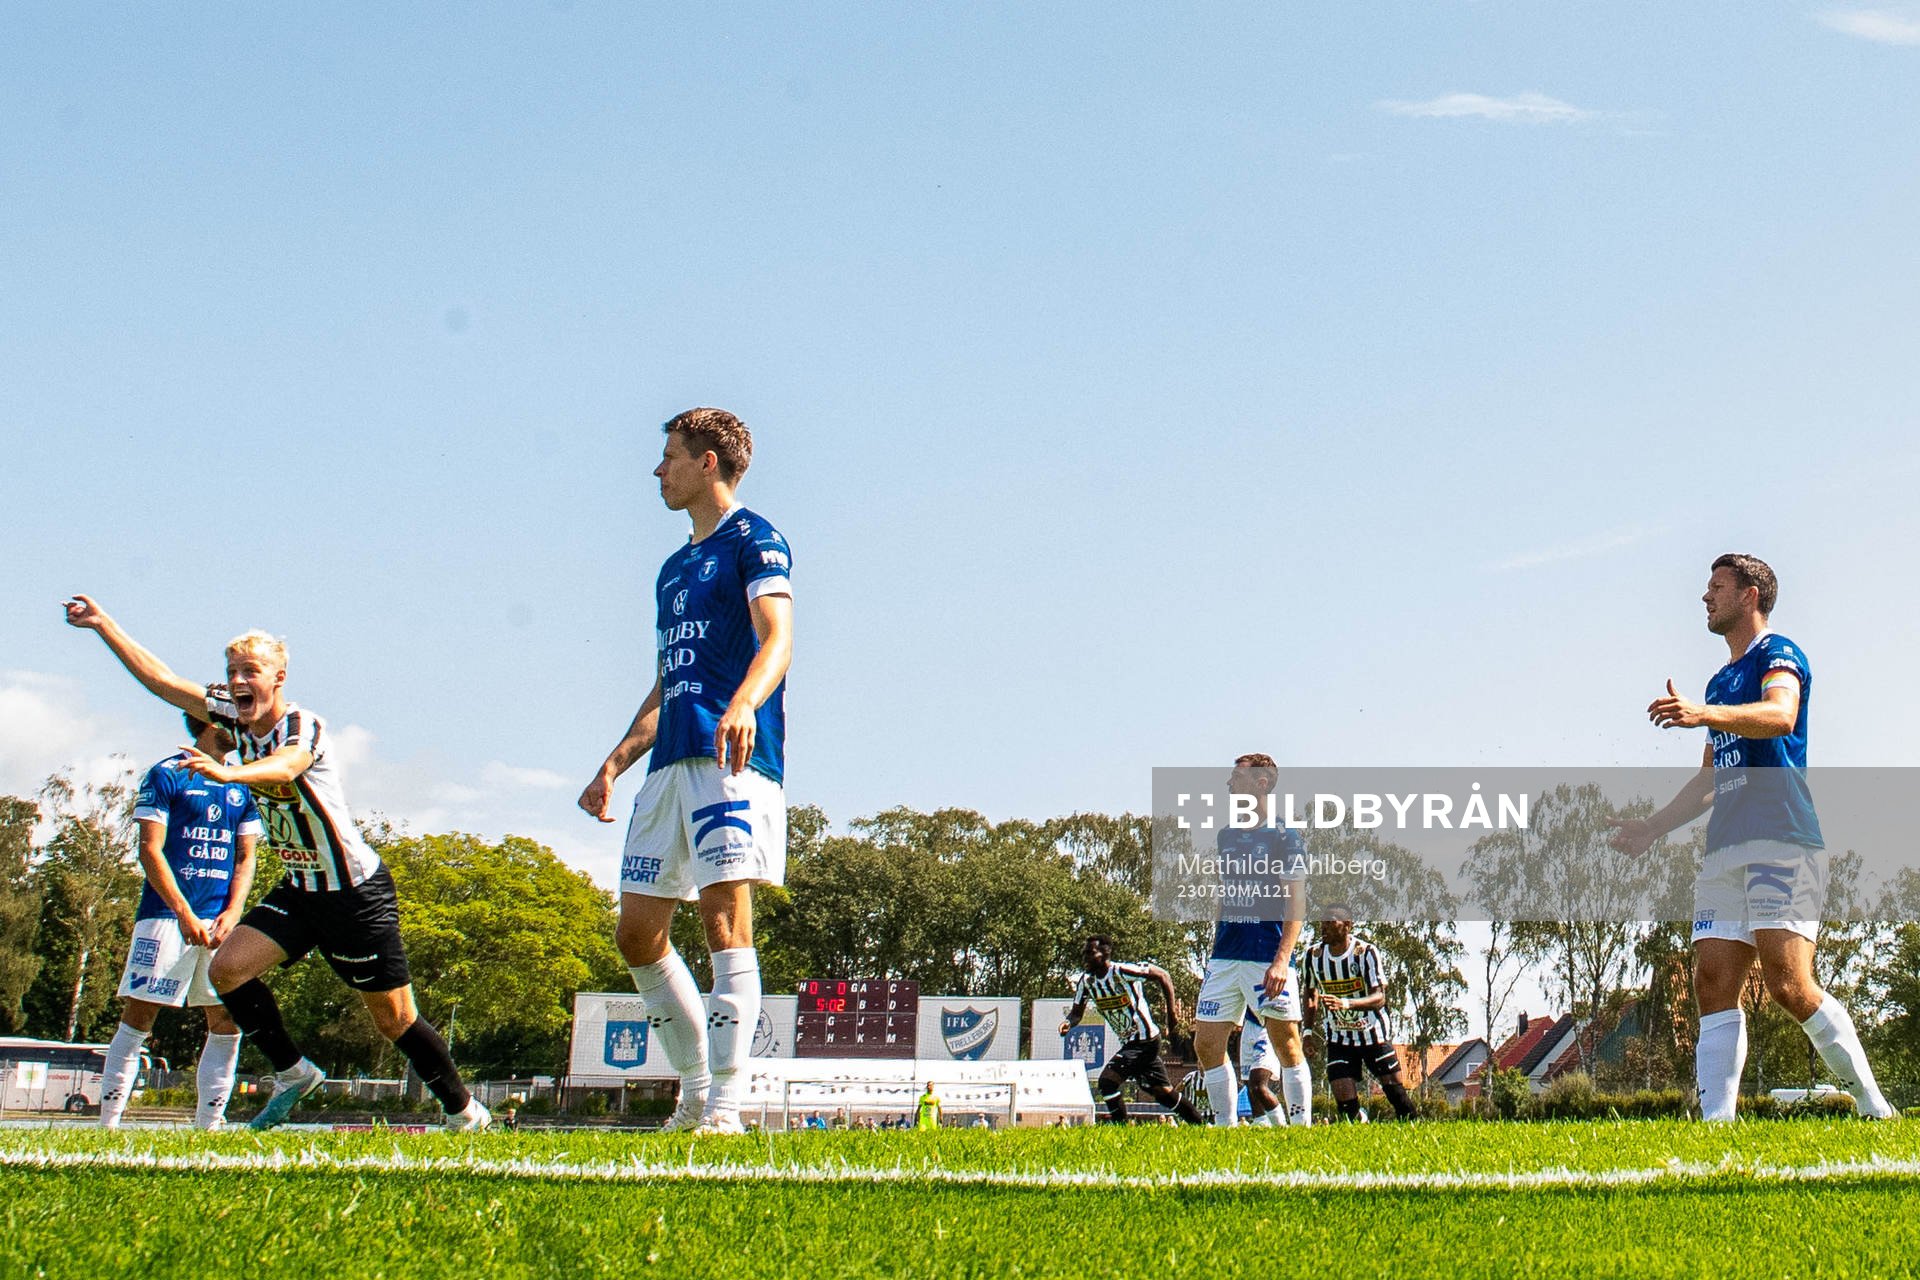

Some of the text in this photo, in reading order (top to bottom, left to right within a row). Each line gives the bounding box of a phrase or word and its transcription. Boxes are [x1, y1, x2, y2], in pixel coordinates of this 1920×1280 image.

[189, 843, 228, 860] GÅRD
[147, 984, 178, 996] SPORT
[799, 981, 858, 995] H 0 0 G
[860, 983, 867, 993] A
[889, 983, 897, 993] C
[816, 998, 846, 1012] 5:02
[859, 1000, 866, 1010] B
[889, 1000, 896, 1010] D
[797, 1016, 804, 1026] E
[828, 1016, 835, 1026] G
[858, 1017, 865, 1026] J
[888, 1017, 894, 1026] L
[946, 1017, 970, 1028] IFK
[796, 1032, 804, 1042] F
[827, 1032, 835, 1043] H
[857, 1033, 865, 1043] K
[886, 1033, 896, 1043] M
[949, 1018, 995, 1049] TRELLEBORG
